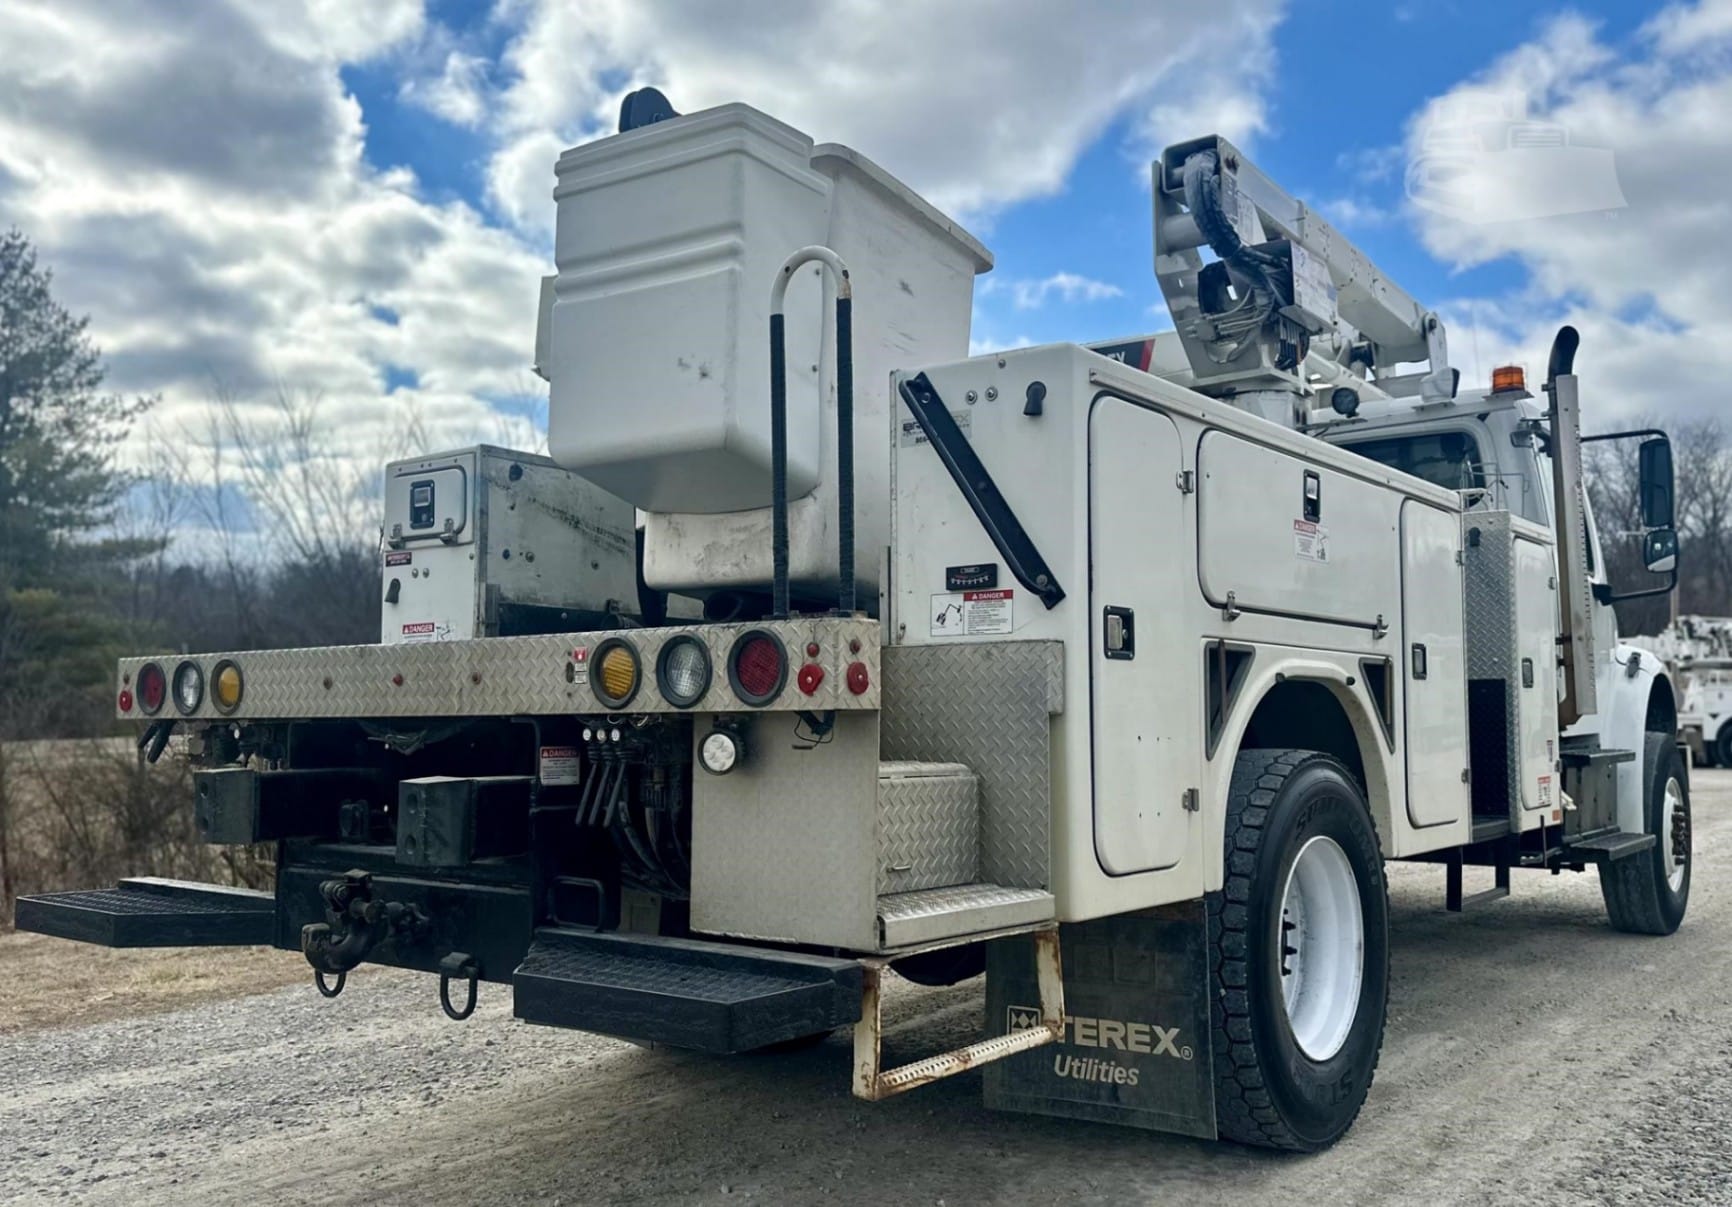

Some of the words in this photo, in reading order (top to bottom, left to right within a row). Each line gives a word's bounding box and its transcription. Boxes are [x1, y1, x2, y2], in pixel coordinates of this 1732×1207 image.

[978, 591, 1004, 600] DANGER
[410, 624, 433, 633] DANGER
[1054, 1054, 1139, 1086] Utilities
